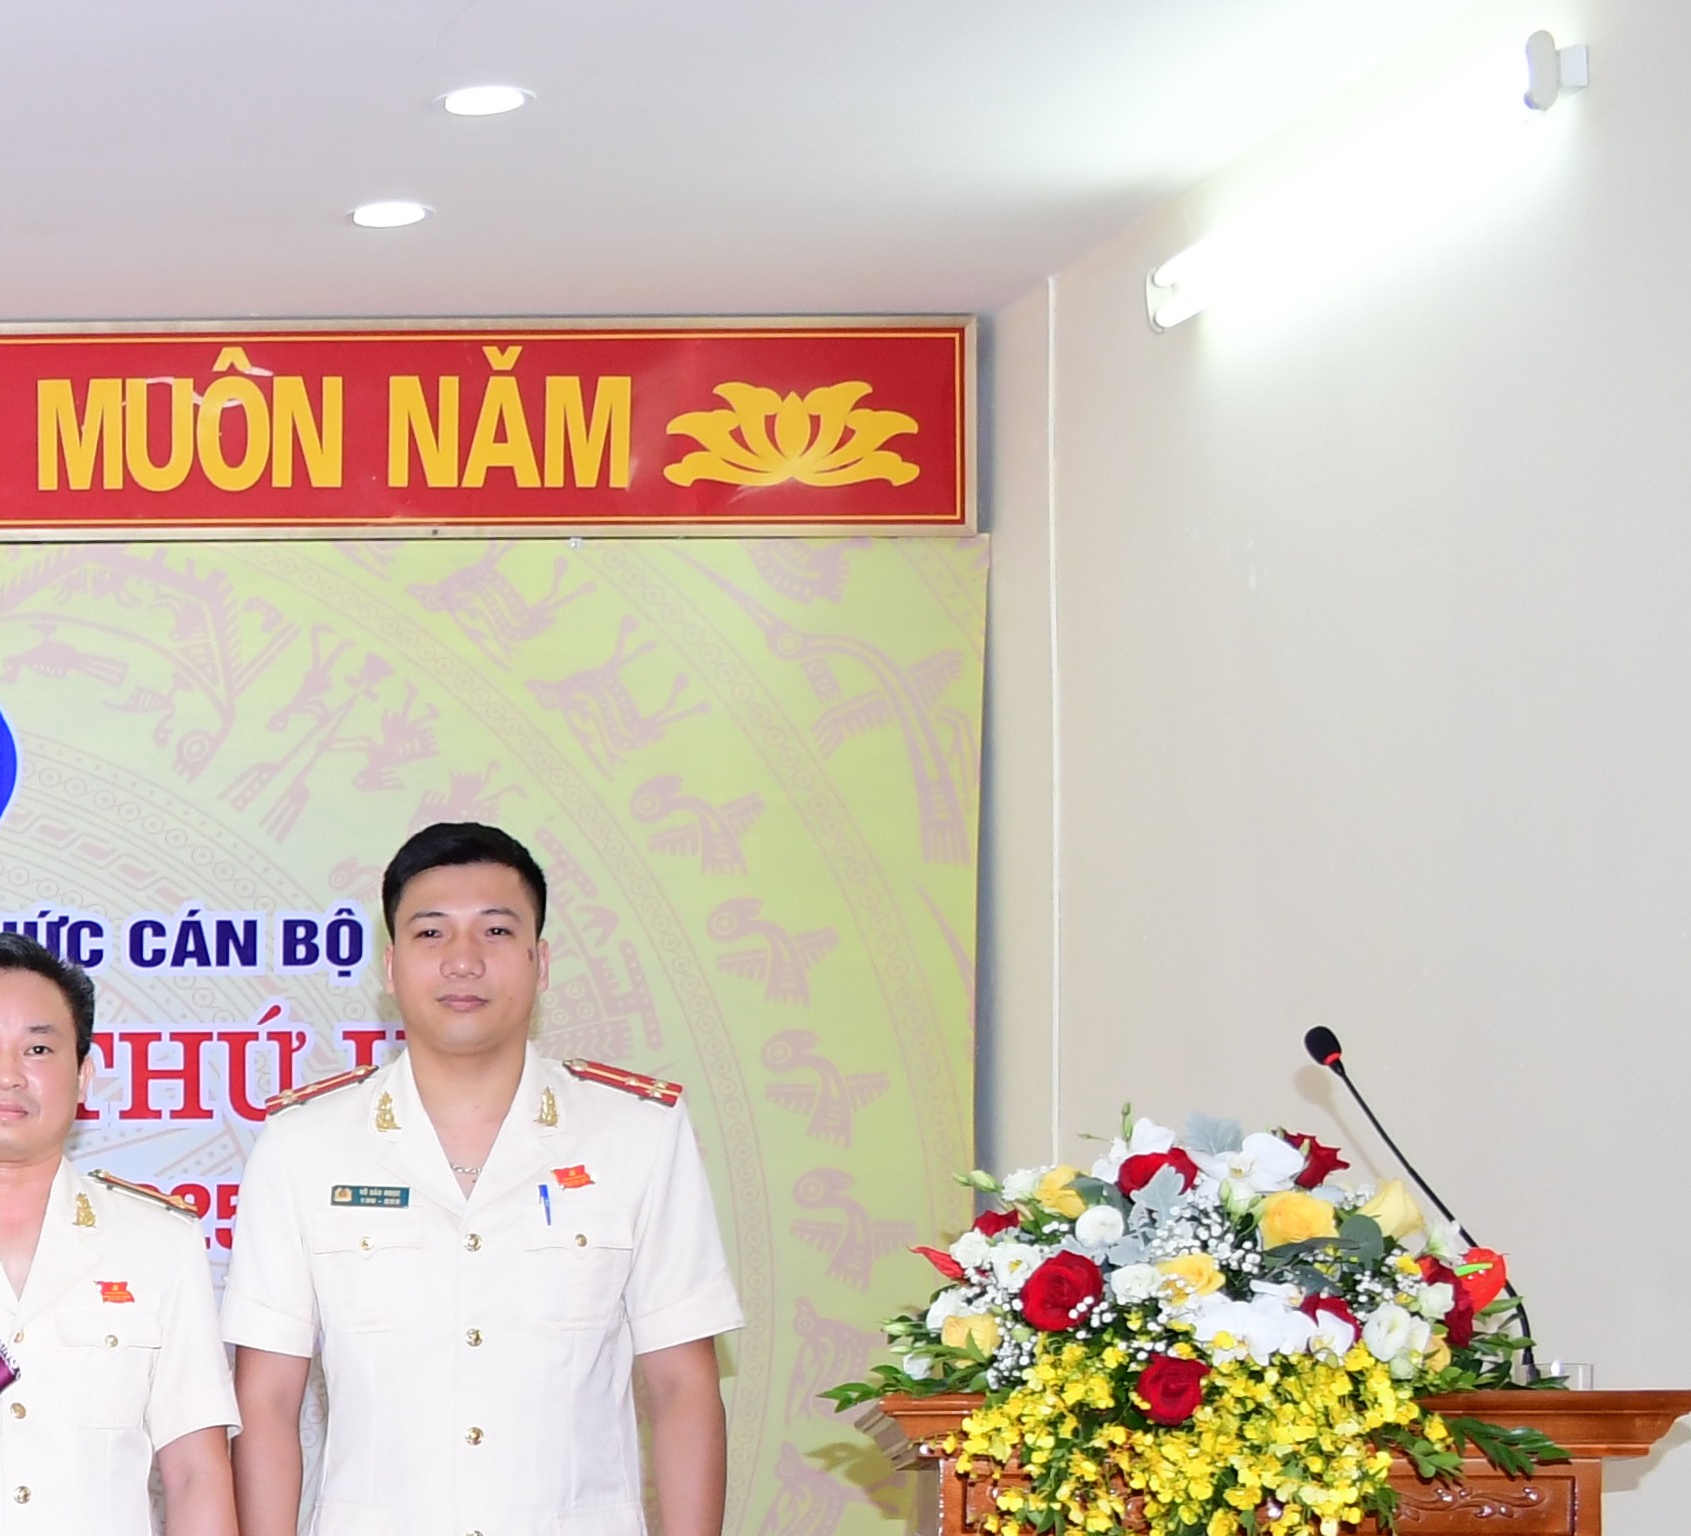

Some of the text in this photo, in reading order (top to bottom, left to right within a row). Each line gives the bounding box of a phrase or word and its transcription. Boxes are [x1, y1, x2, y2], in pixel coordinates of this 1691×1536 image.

[37, 347, 343, 491] MUÔN
[388, 346, 631, 488] NĂM
[127, 908, 259, 969] CÁN
[281, 907, 365, 978] BỘ
